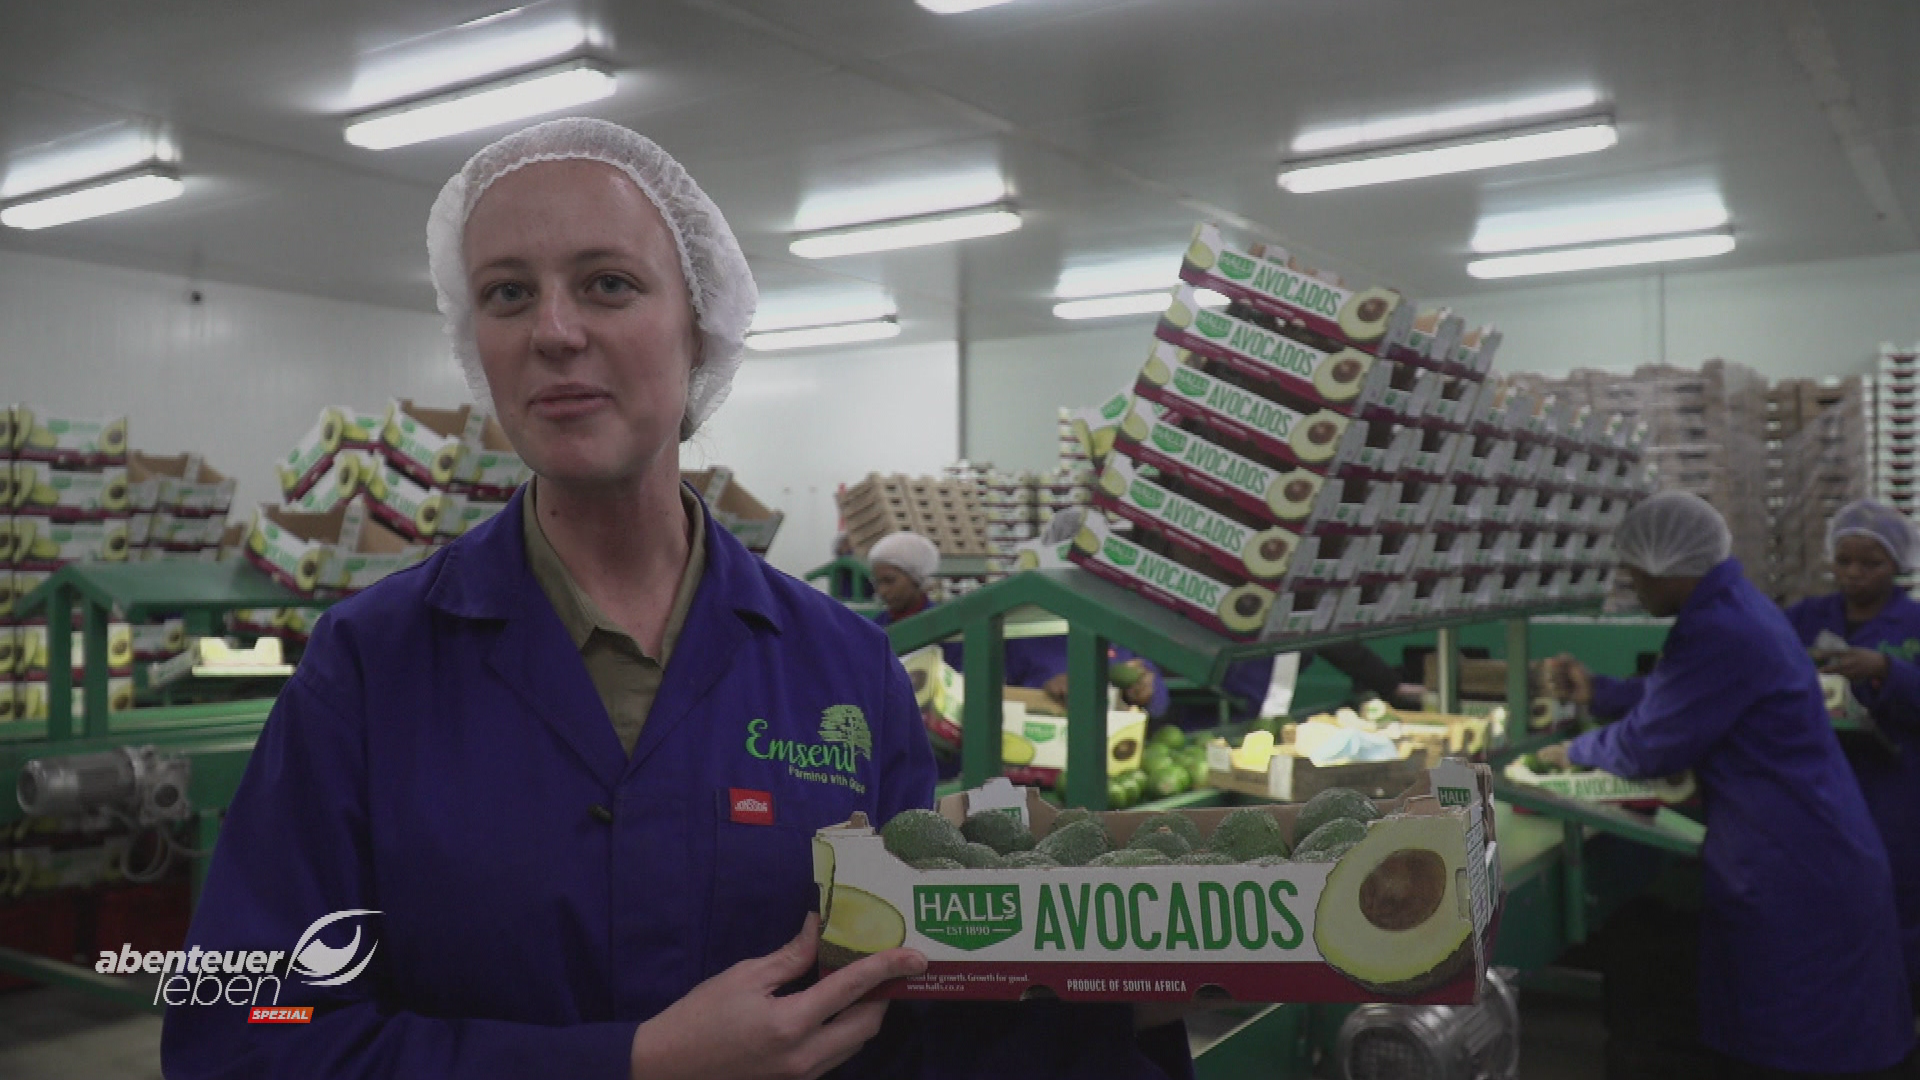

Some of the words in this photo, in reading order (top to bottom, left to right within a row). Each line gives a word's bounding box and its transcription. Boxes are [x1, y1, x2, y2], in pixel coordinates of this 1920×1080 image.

[1252, 265, 1342, 317] AVOCADOS
[1229, 324, 1317, 377] AVOCADOS
[1206, 383, 1293, 438] AVOCADOS
[1184, 440, 1269, 495] AVOCADOS
[1161, 496, 1245, 552] AVOCADOS
[1136, 553, 1221, 608] AVOCADOS
[788, 764, 828, 784] Farming
[919, 892, 1017, 922] HALLS
[946, 926, 962, 936] EST
[965, 925, 990, 936] 1890
[1034, 879, 1304, 951] AVOCADOS
[907, 983, 965, 991] www.halls.co.za
[927, 973, 937, 982] for
[939, 973, 967, 984] growth.
[968, 973, 995, 982] Growth
[996, 973, 1006, 982] for
[1067, 979, 1107, 992] PRODUCE
[1109, 980, 1120, 992] OF
[1122, 980, 1152, 992] SOUTH
[1154, 980, 1187, 992] AFRICA
